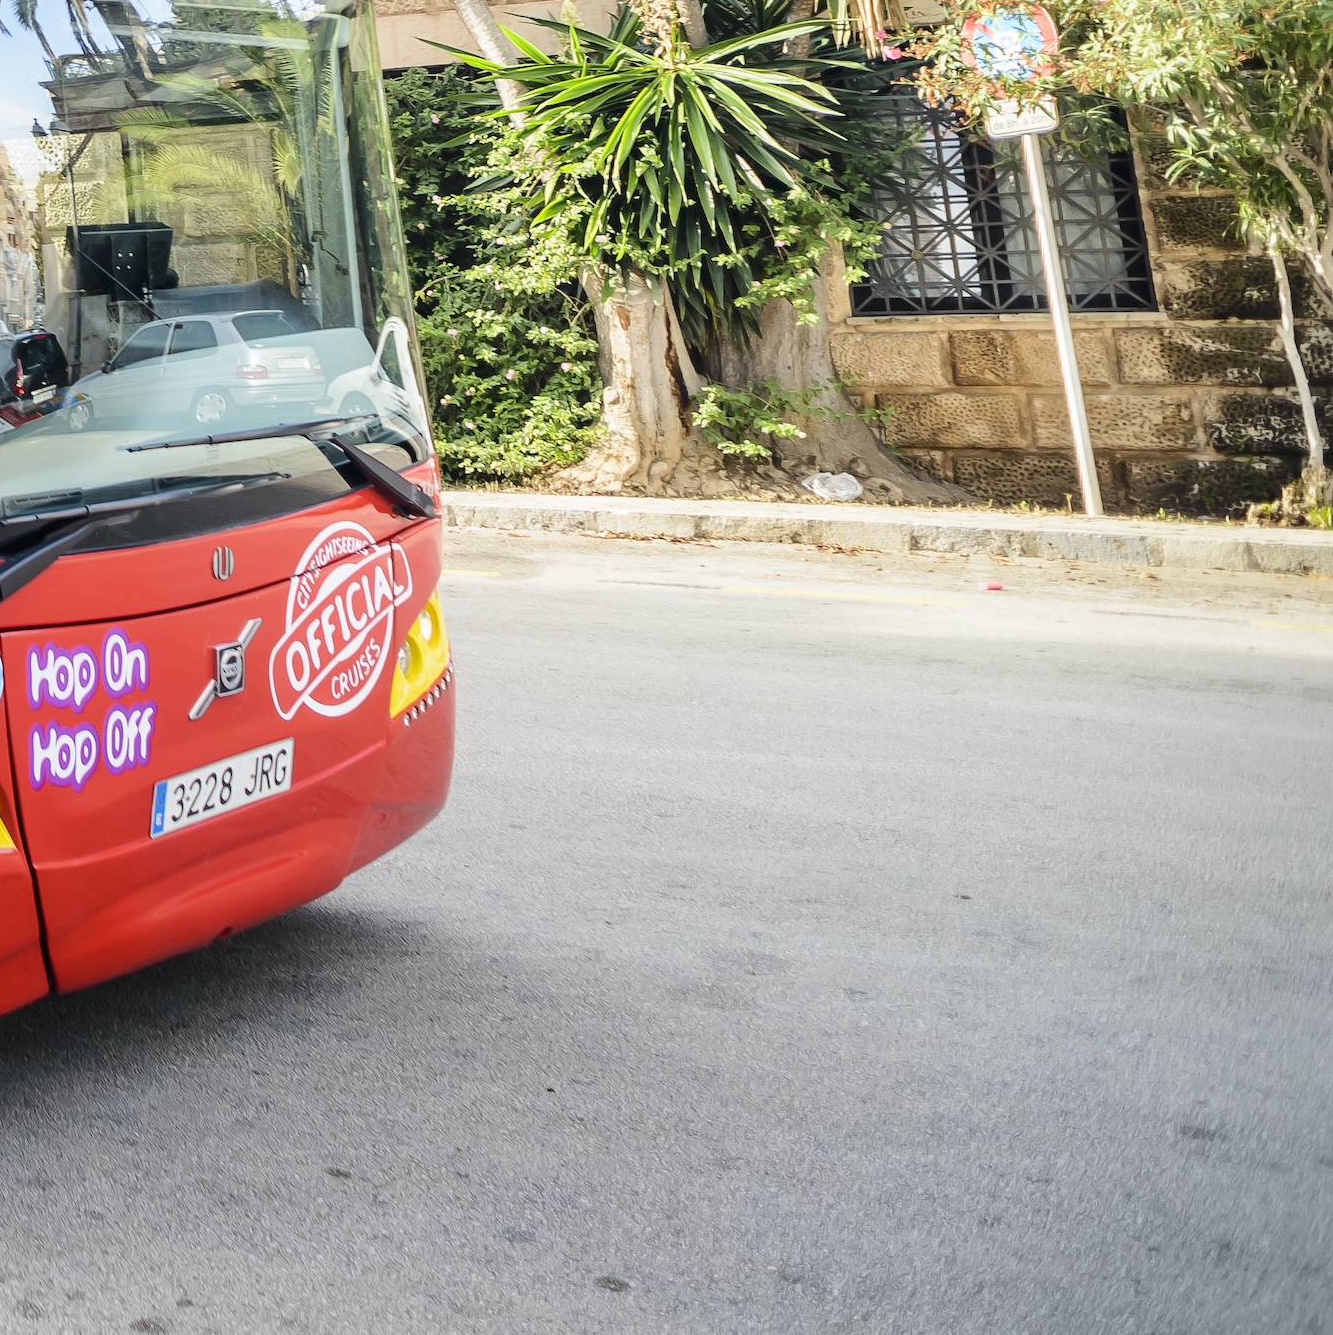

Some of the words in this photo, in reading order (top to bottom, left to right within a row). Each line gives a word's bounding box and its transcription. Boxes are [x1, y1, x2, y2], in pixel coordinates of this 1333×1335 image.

[285, 557, 405, 692] OFFICIAL
[32, 648, 96, 708] Hop
[104, 633, 146, 693] On
[330, 637, 381, 700] CRUISES
[33, 727, 97, 785] Hop
[106, 706, 154, 769] Off
[171, 766, 234, 822] 3228
[244, 748, 287, 796] JRG
